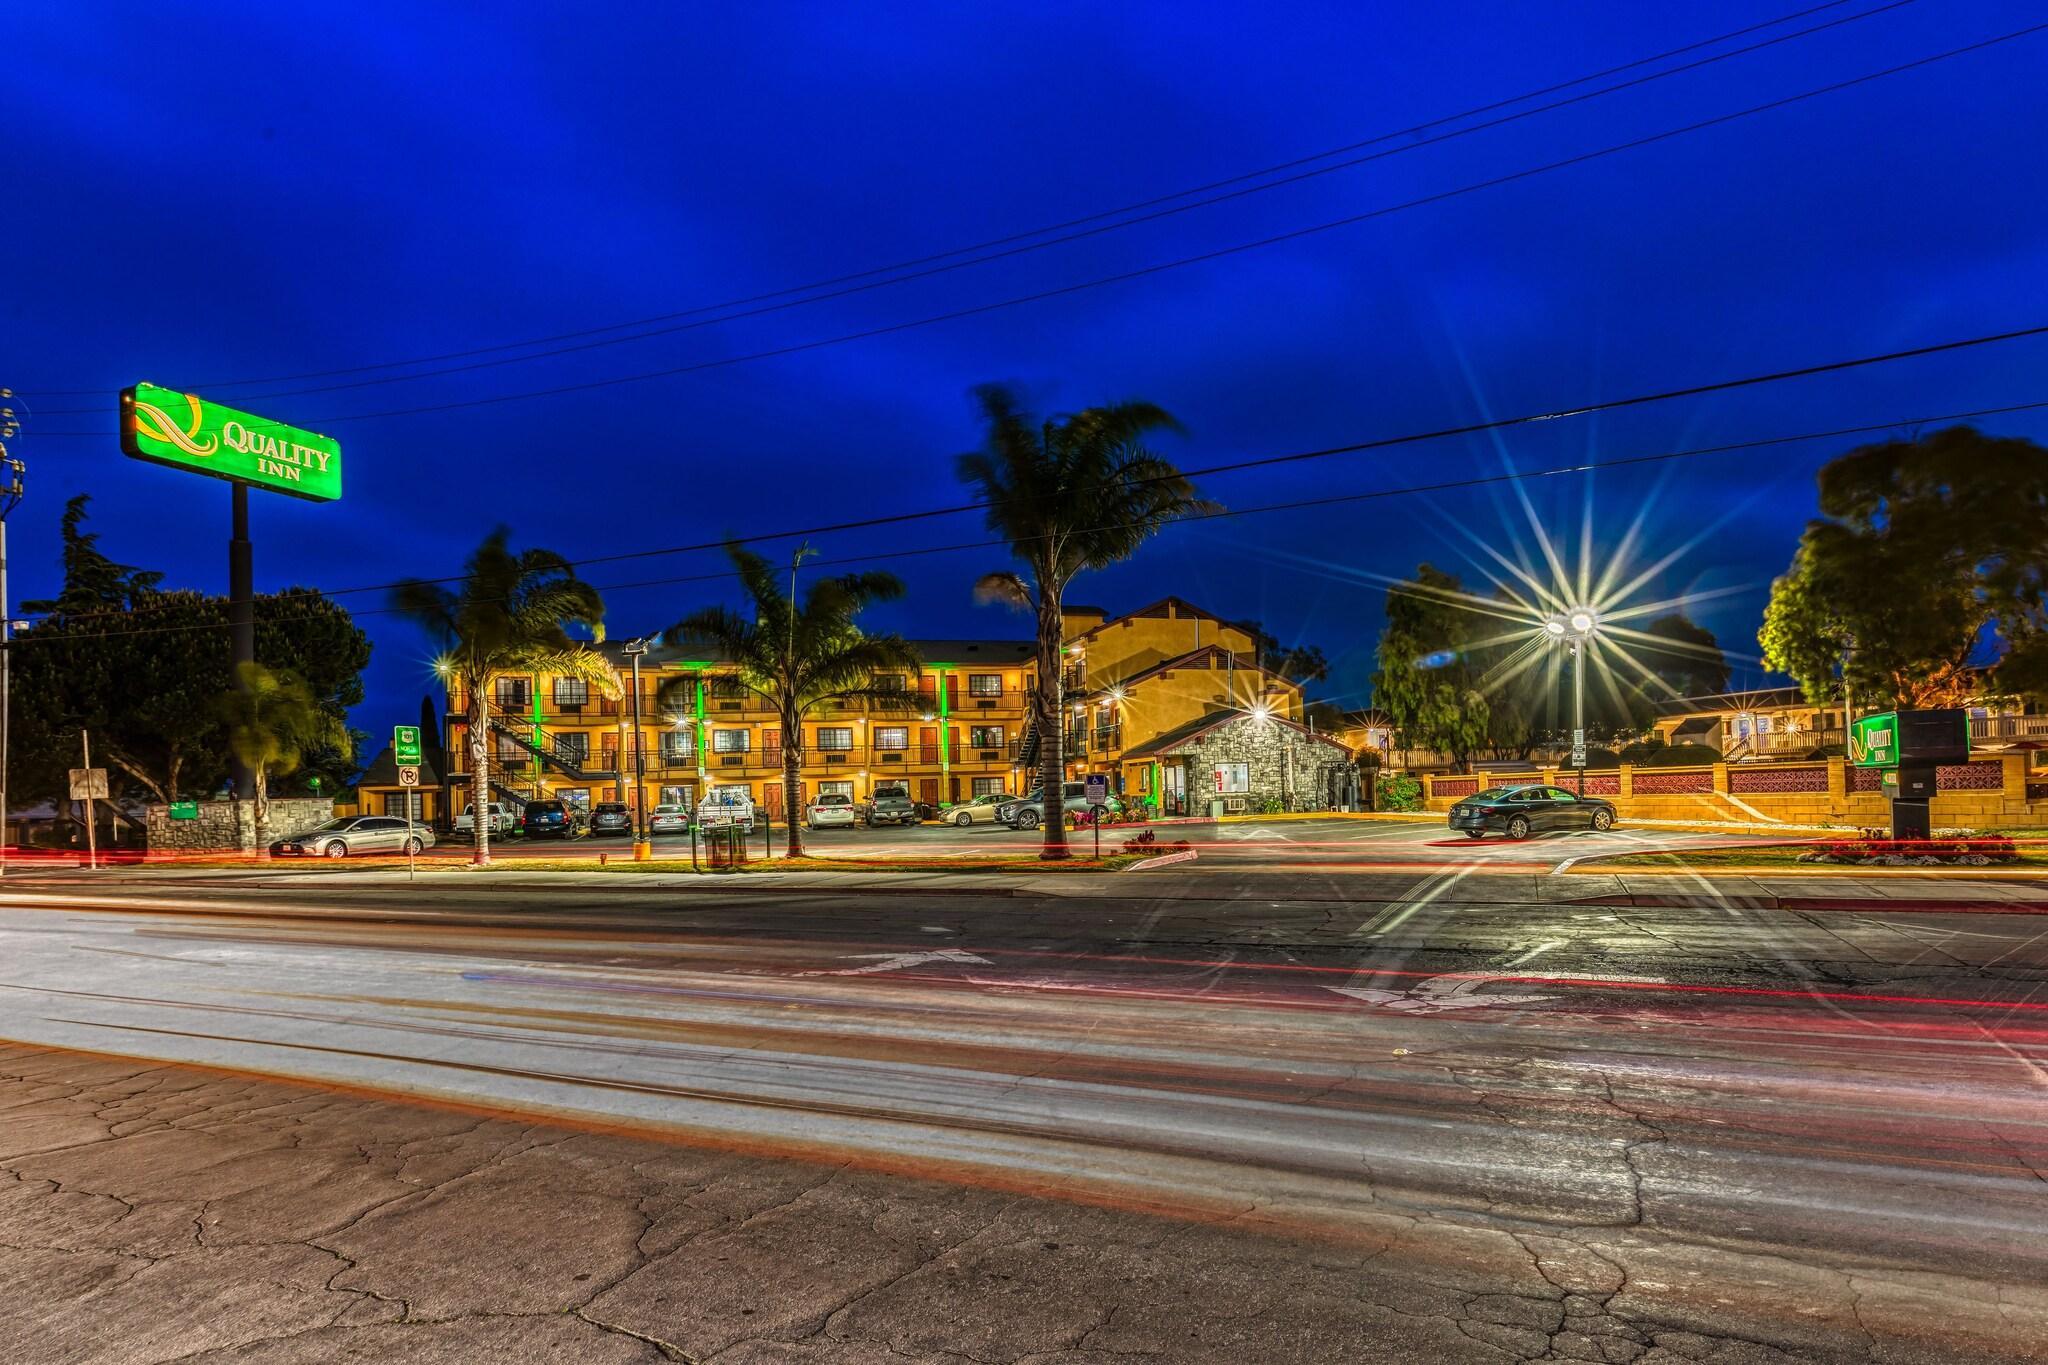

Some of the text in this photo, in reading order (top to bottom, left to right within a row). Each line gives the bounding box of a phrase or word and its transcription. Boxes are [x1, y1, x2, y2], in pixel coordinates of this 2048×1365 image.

[223, 421, 331, 472] QUALITY
[258, 458, 301, 481] INN
[1867, 728, 1892, 750] QUALITY
[1874, 750, 1886, 761] INN
